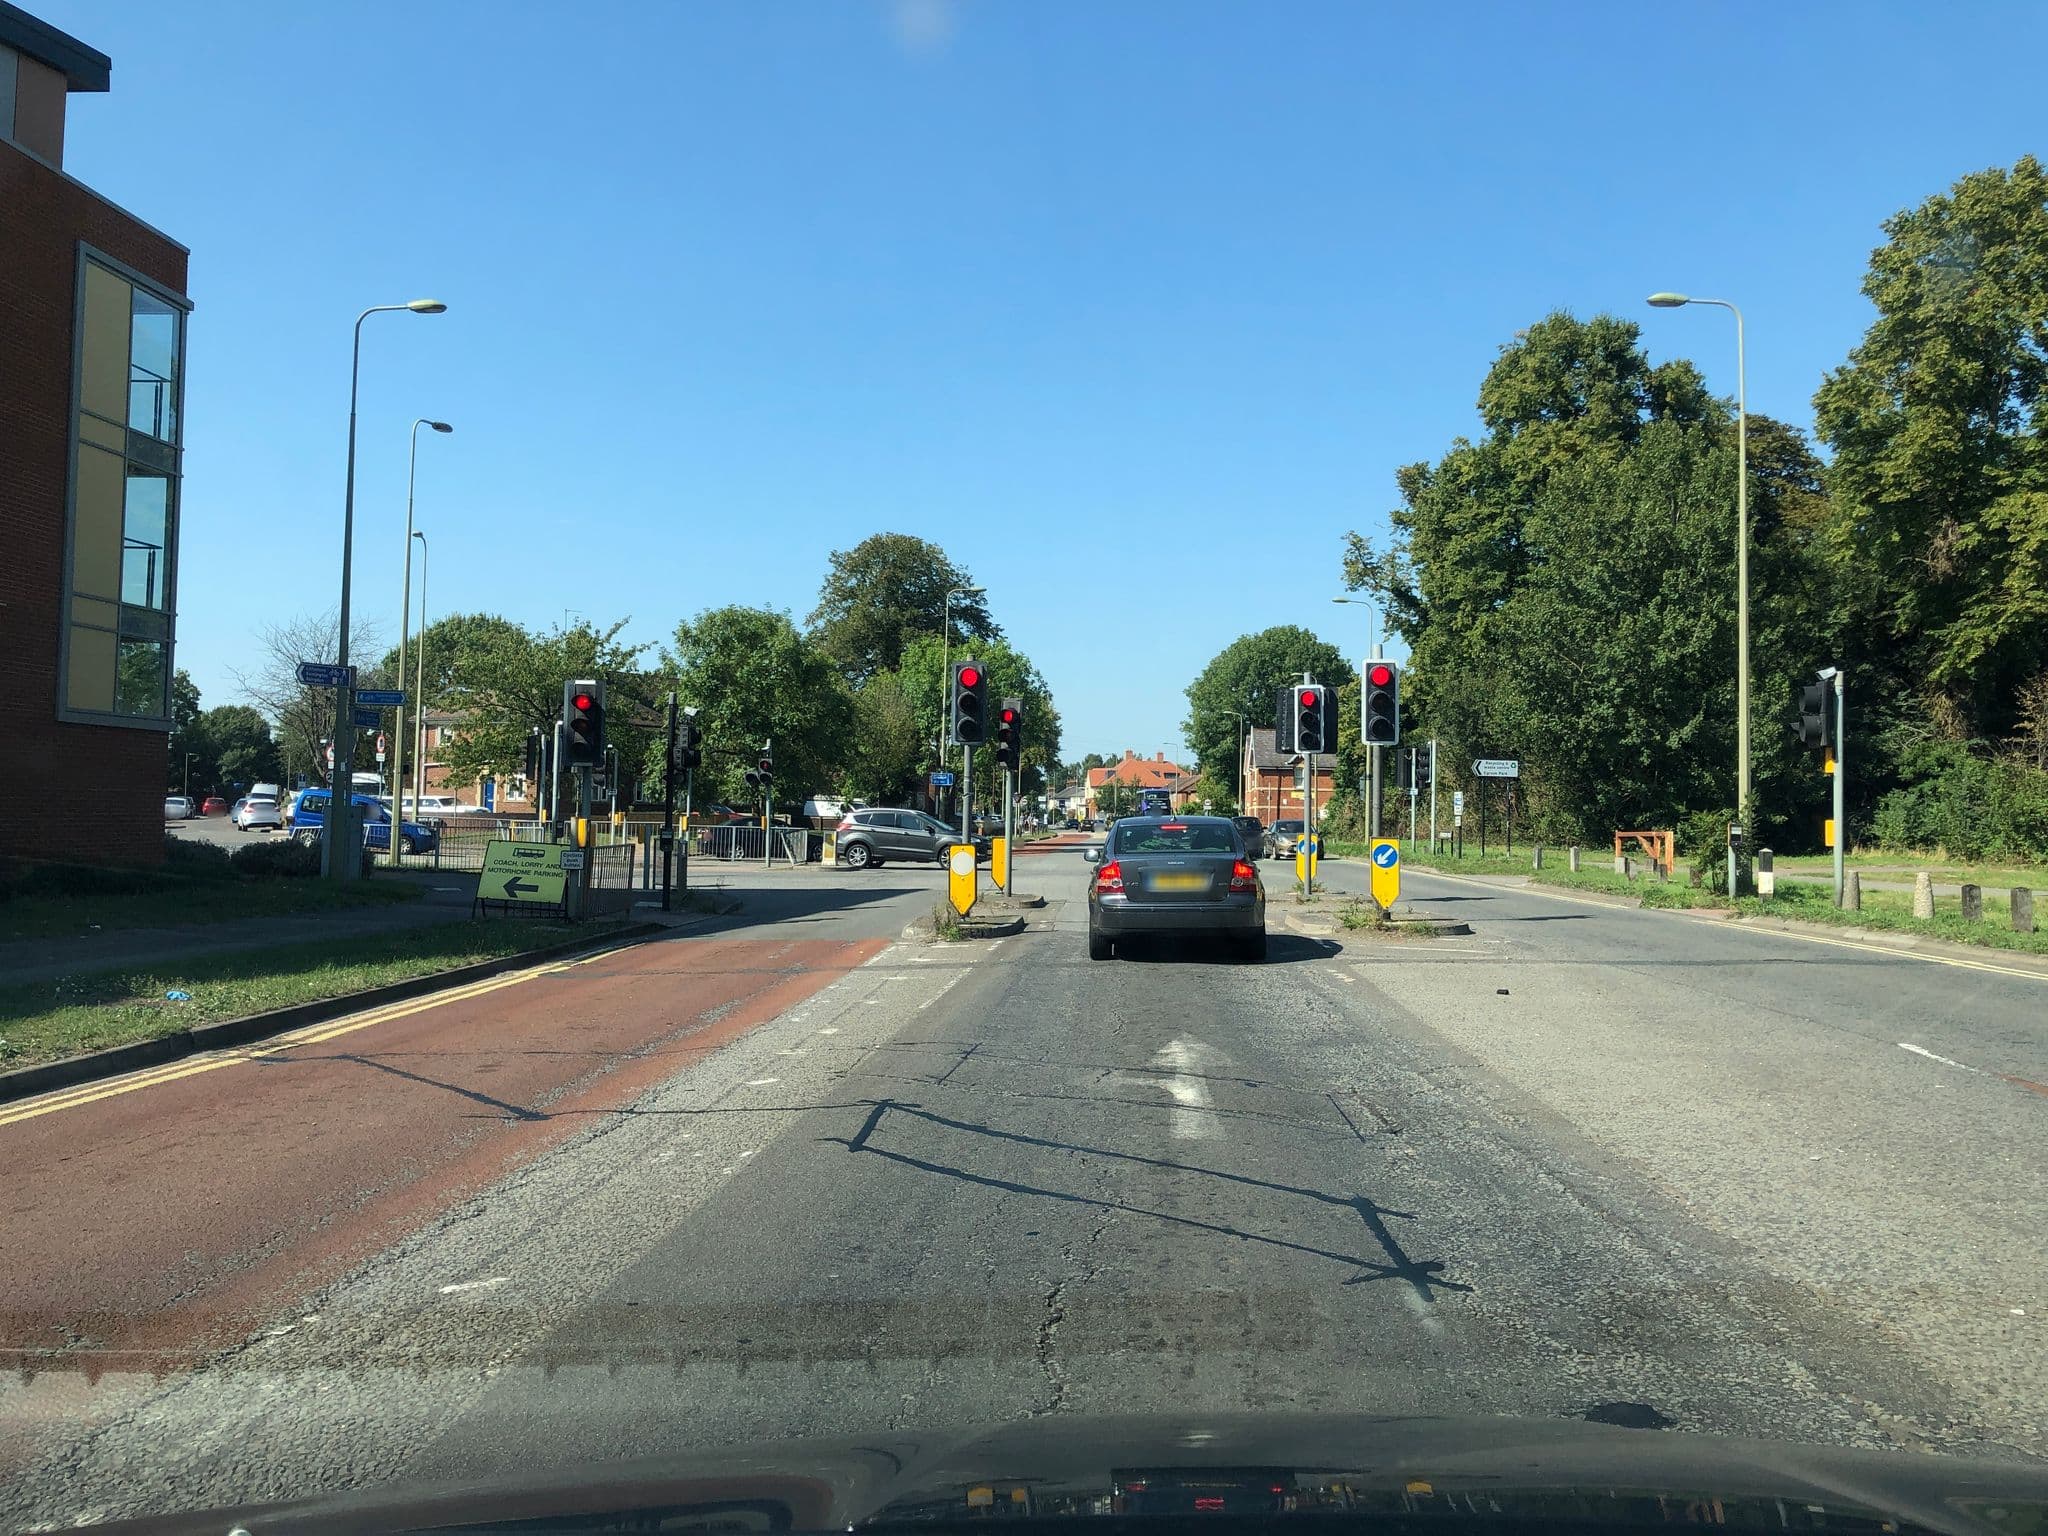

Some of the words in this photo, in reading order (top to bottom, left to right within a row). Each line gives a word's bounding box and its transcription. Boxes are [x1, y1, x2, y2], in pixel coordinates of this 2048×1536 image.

[493, 859, 518, 867] COACH,
[521, 860, 543, 868] LORRY
[487, 867, 531, 876] MOTORHOME
[533, 870, 564, 878] PARKING
